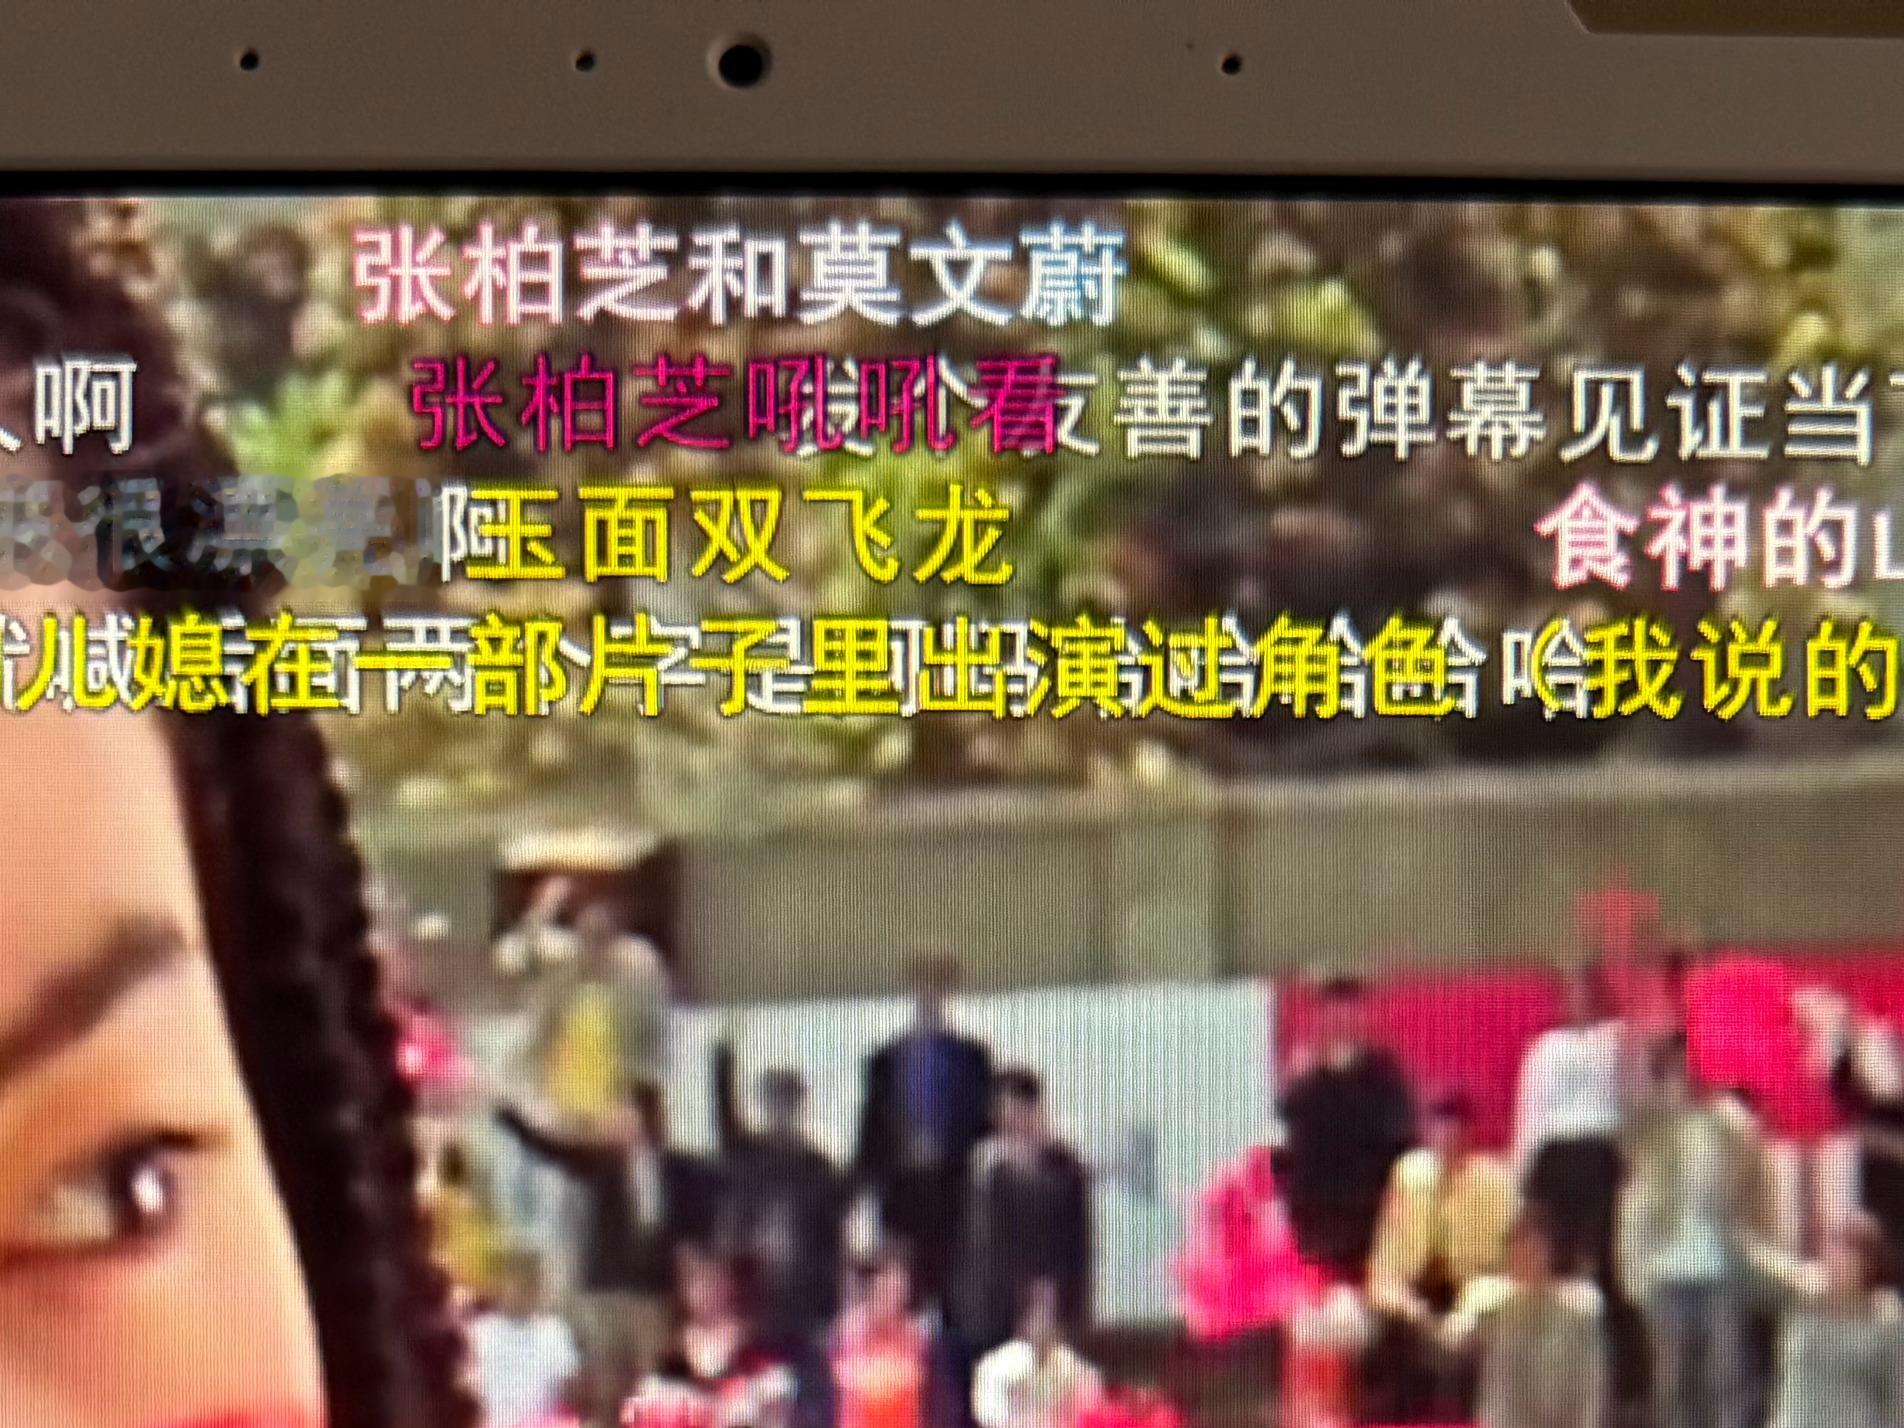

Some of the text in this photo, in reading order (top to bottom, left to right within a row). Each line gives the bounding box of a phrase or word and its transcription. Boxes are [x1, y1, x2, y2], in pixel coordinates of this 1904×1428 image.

[351, 222, 1128, 328] 张柏芝和莫文蔚
[465, 482, 1014, 585] 玉面双飞龙
